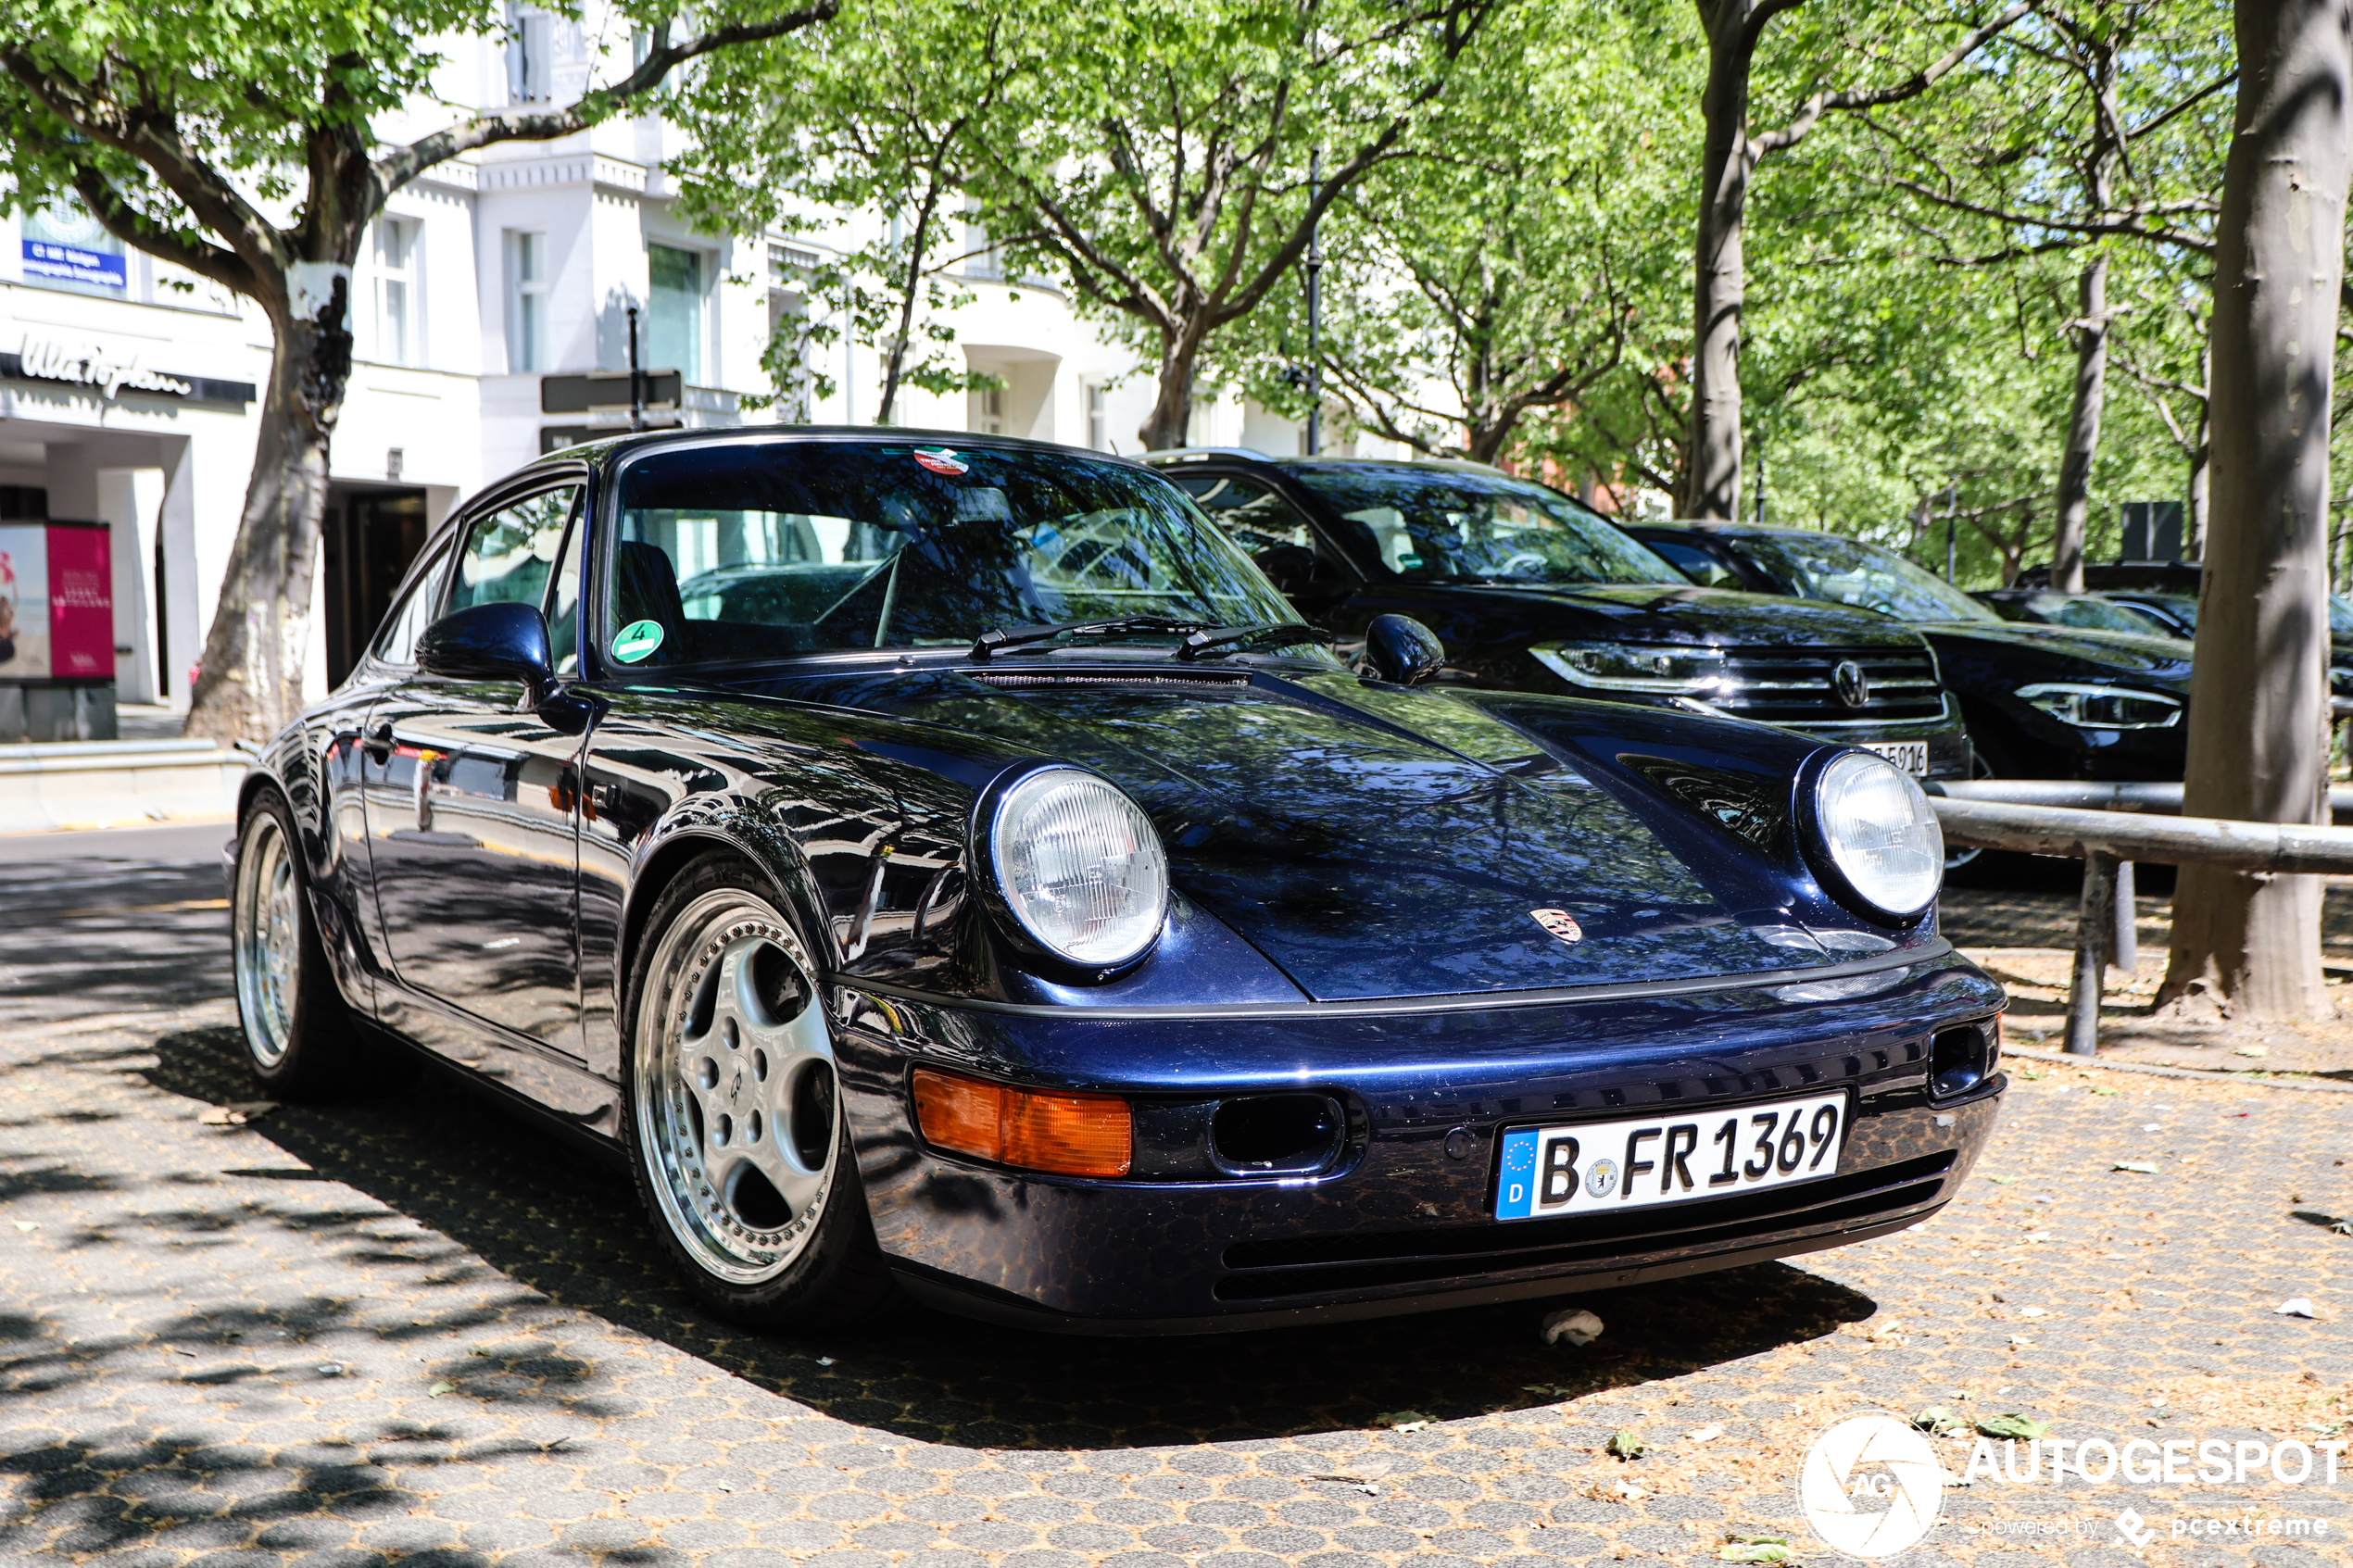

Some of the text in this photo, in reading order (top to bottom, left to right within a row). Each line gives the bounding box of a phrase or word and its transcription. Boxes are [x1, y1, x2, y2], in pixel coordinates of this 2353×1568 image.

[632, 623, 645, 640] 4
[1888, 745, 1924, 772] 5916
[1541, 1104, 1838, 1204] B FR 1369
[1509, 1184, 1524, 1203] D
